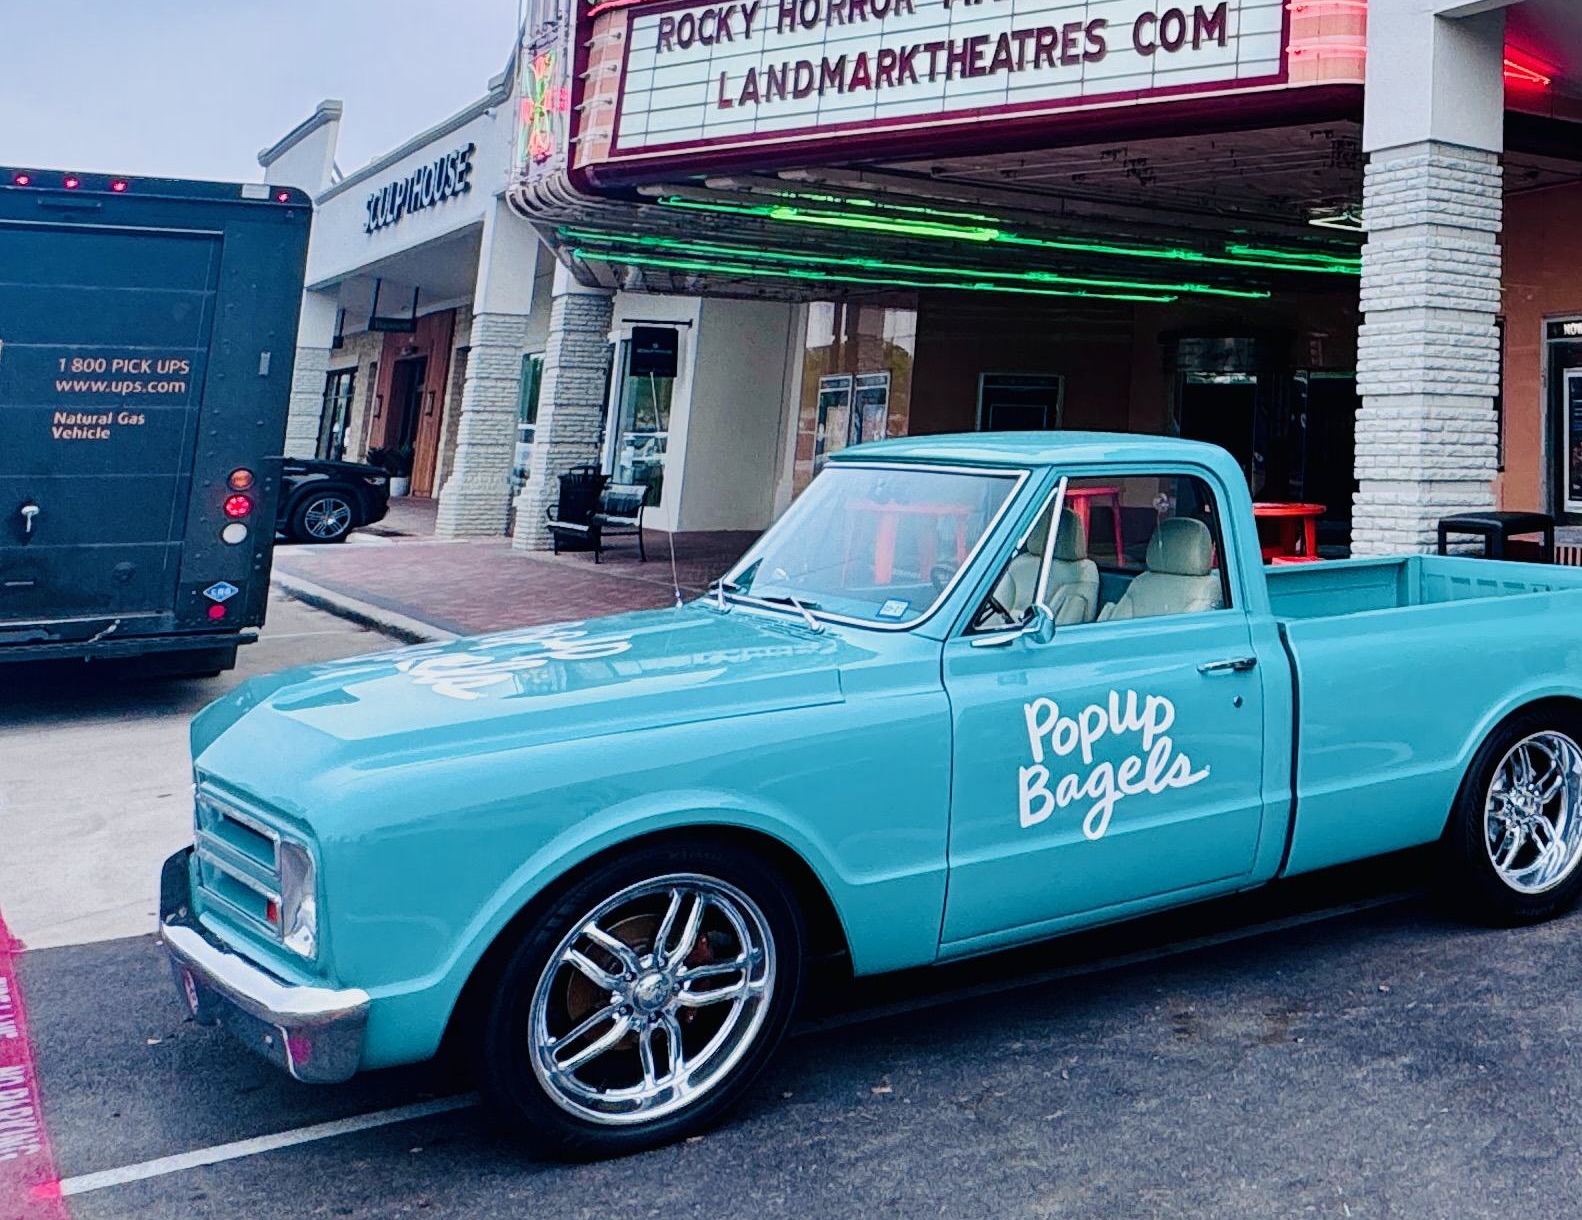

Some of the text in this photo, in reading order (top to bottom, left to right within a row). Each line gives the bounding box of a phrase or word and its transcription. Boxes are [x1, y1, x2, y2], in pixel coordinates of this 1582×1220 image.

[656, 0, 761, 54] ROCKY
[717, 1, 1229, 110] LANDMARKTHEATRES COM
[59, 358, 190, 375] 1 800 PICK UPS
[56, 380, 185, 395] www.ups.com
[53, 412, 145, 425] Natural Gas
[51, 426, 111, 440] Vehicle
[1019, 736, 1210, 840] Bagels
